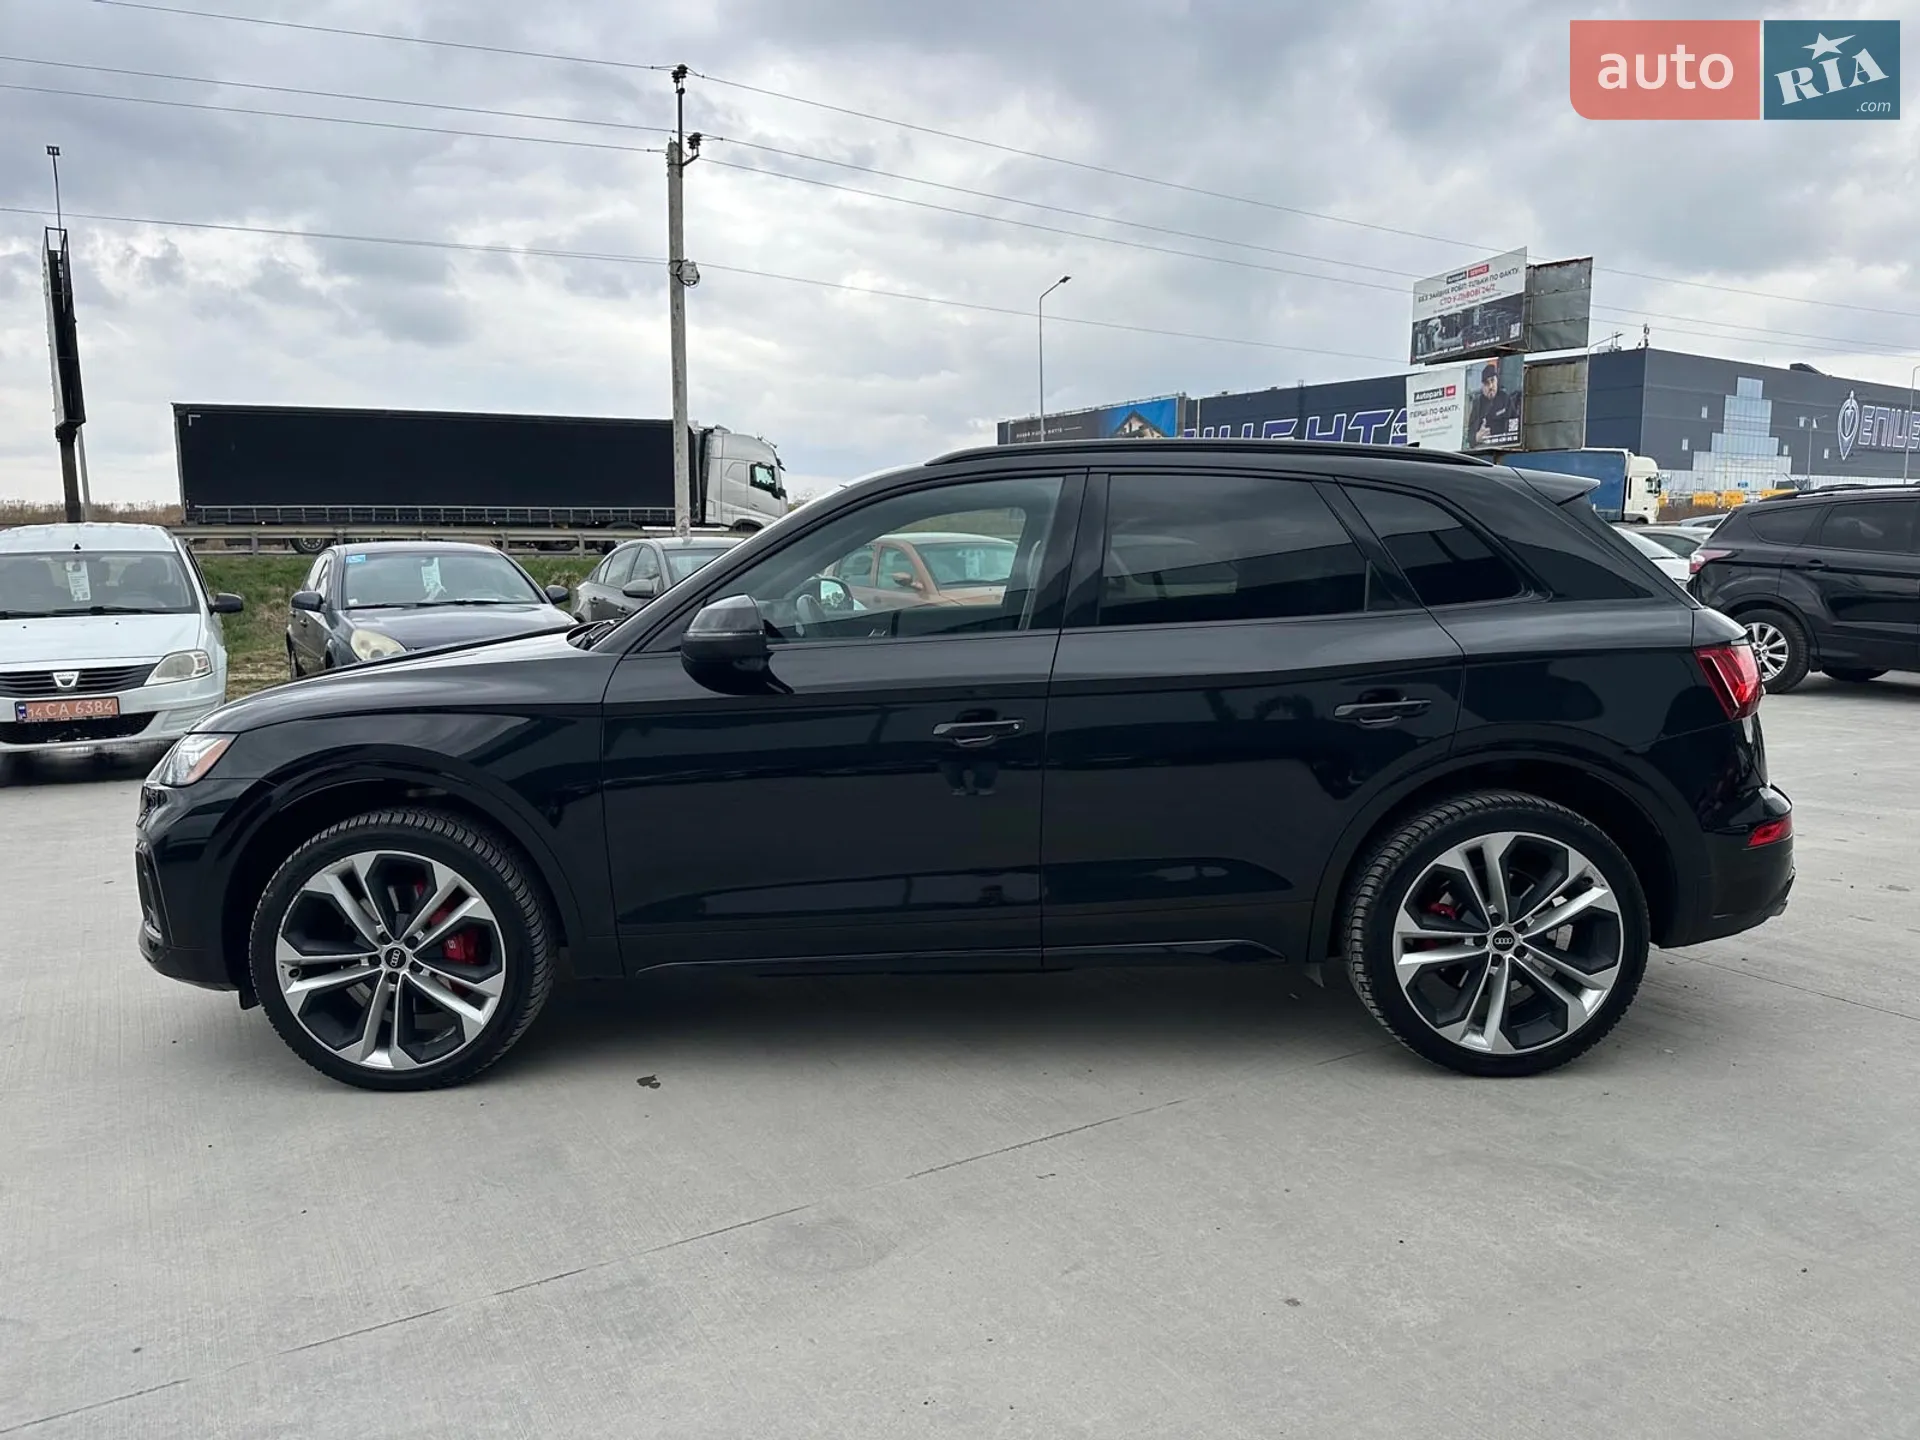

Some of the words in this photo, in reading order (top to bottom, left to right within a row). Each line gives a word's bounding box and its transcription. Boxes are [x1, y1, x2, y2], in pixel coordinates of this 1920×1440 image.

[1489, 273, 1499, 282] ПО
[1415, 388, 1443, 400] Autopark
[28, 707, 42, 718] 14
[46, 703, 70, 716] CA
[75, 700, 113, 714] 6384
